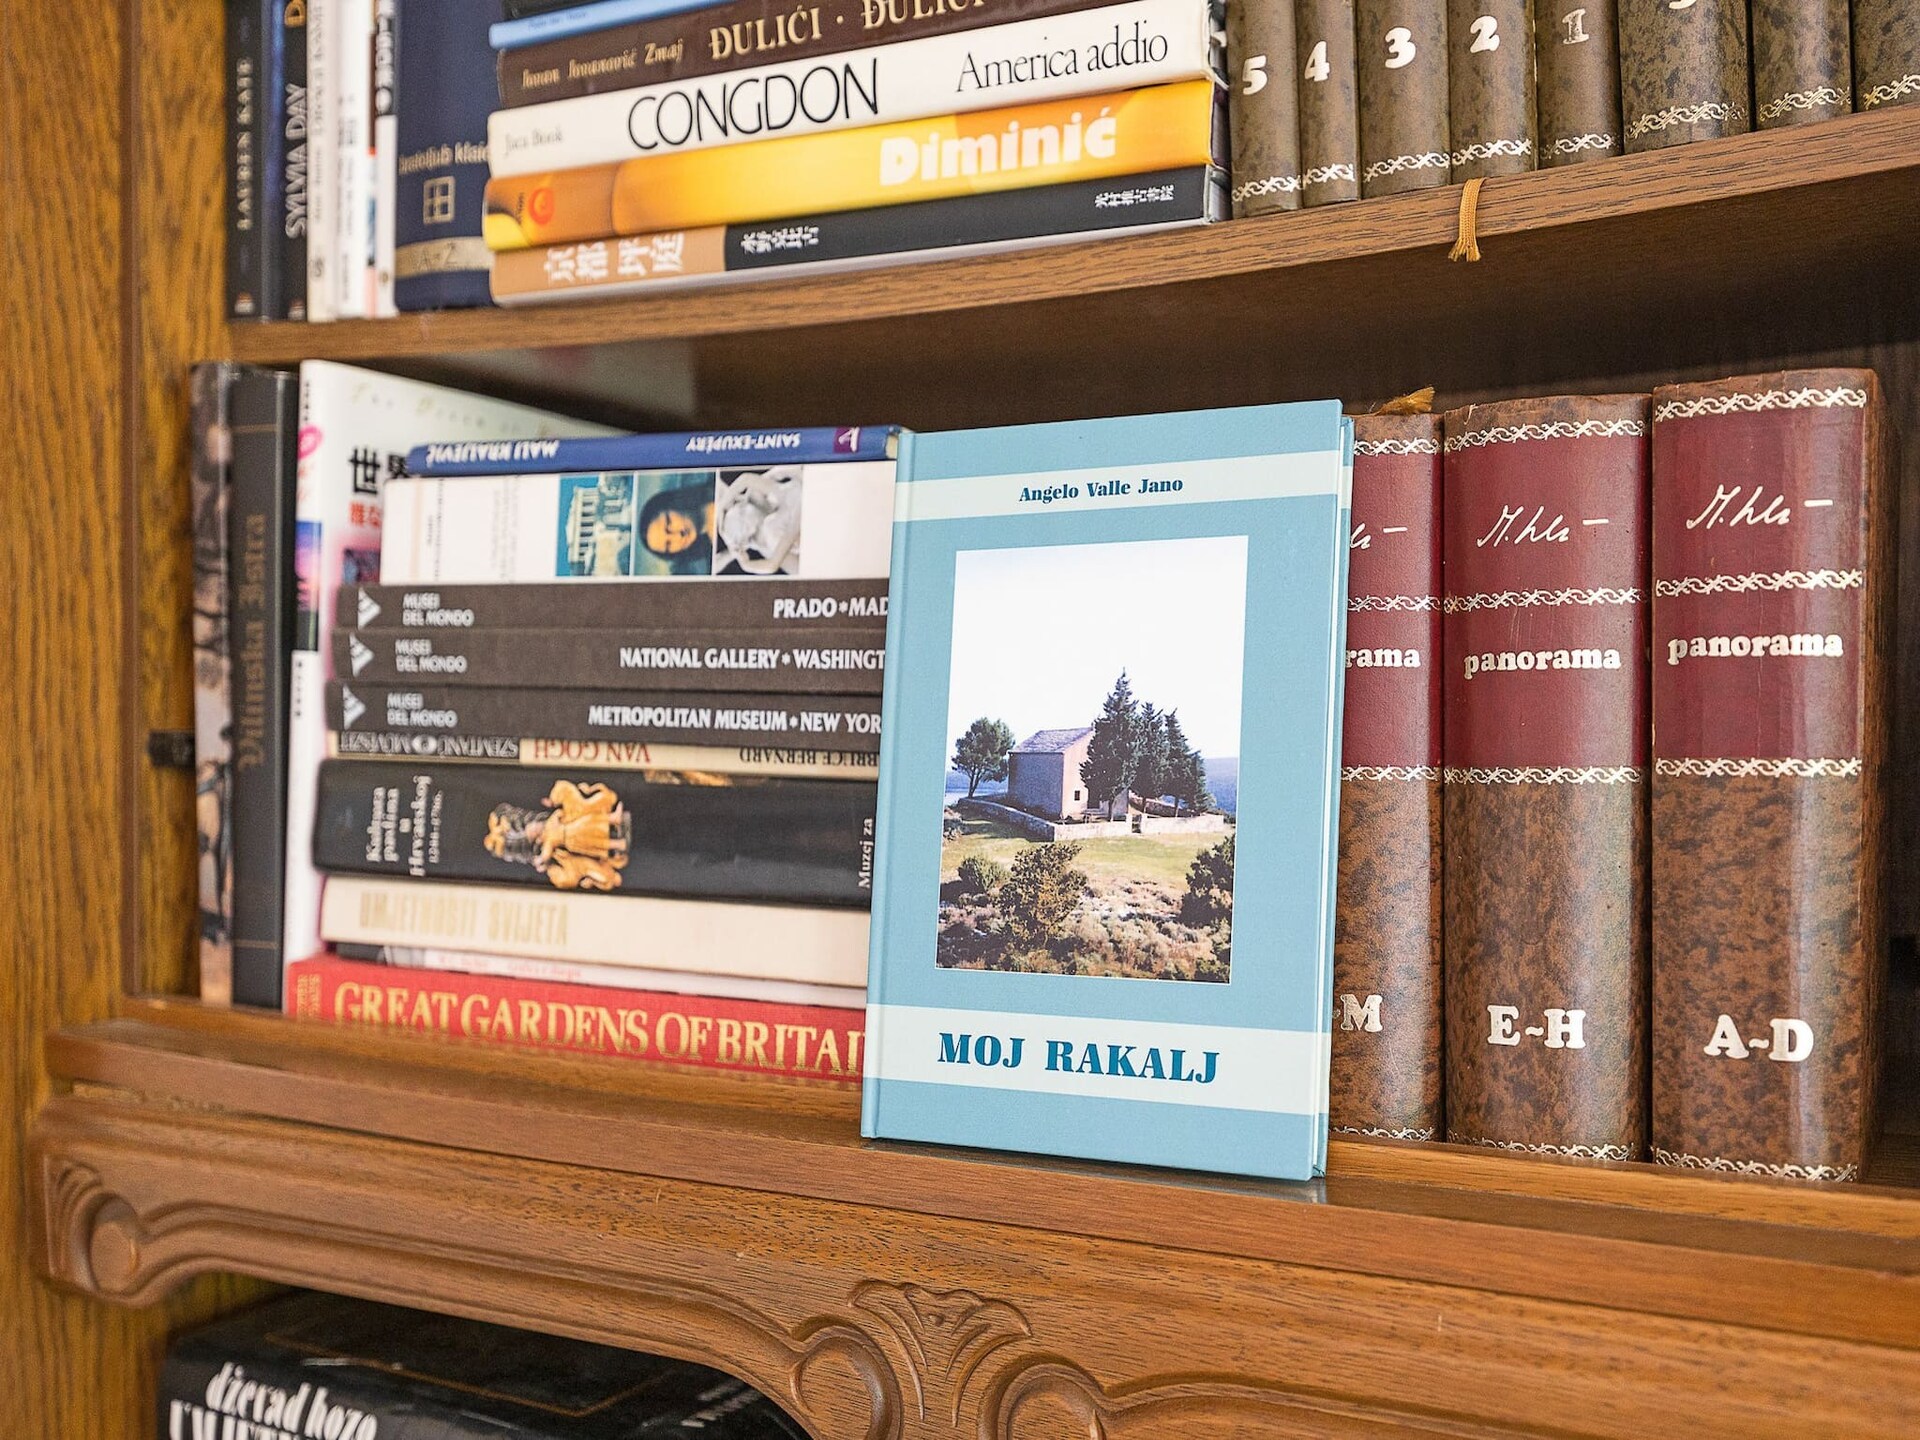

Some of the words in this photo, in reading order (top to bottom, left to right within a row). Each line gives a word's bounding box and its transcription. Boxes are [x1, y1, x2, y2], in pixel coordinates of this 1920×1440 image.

[709, 5, 823, 61] ĐULIĆI
[1469, 15, 1501, 54] 2
[1562, 8, 1588, 44] 1
[1304, 41, 1331, 83] 4
[1384, 26, 1417, 69] 3
[628, 58, 878, 149] CONGDON
[956, 38, 1080, 93] America
[1087, 20, 1169, 71] addio
[1243, 55, 1268, 96] 5
[285, 83, 307, 140] DAY
[879, 107, 1118, 187] Diminić
[285, 143, 307, 239] SYLVIA
[686, 432, 801, 455] SAINT-EXUPÉRY
[1019, 484, 1079, 505] Angelo
[1086, 479, 1131, 498] Valle
[1138, 476, 1184, 495] Jano
[773, 598, 837, 619] PRADO
[620, 647, 702, 669] NATIONAL
[704, 648, 780, 669] GALLERY
[1462, 648, 1622, 681] panorama
[1666, 632, 1844, 666] panorama
[588, 704, 712, 729] METROPOLITAN
[714, 708, 788, 731] MUSEUM
[801, 711, 841, 733] NEW
[534, 739, 600, 761] GOGH
[606, 741, 651, 763] VAN
[739, 746, 816, 765] BERNARD
[863, 818, 873, 836] za
[858, 840, 874, 889] Muzej
[334, 981, 458, 1034] GREAT
[460, 993, 648, 1056] GARDENS
[656, 1012, 712, 1062] OF
[716, 1017, 866, 1077] BRITAI
[1486, 1004, 1586, 1049] E-H
[1703, 1013, 1815, 1062] A-D
[938, 1031, 1024, 1069] MOJ
[1044, 1039, 1220, 1084] RAKALJ
